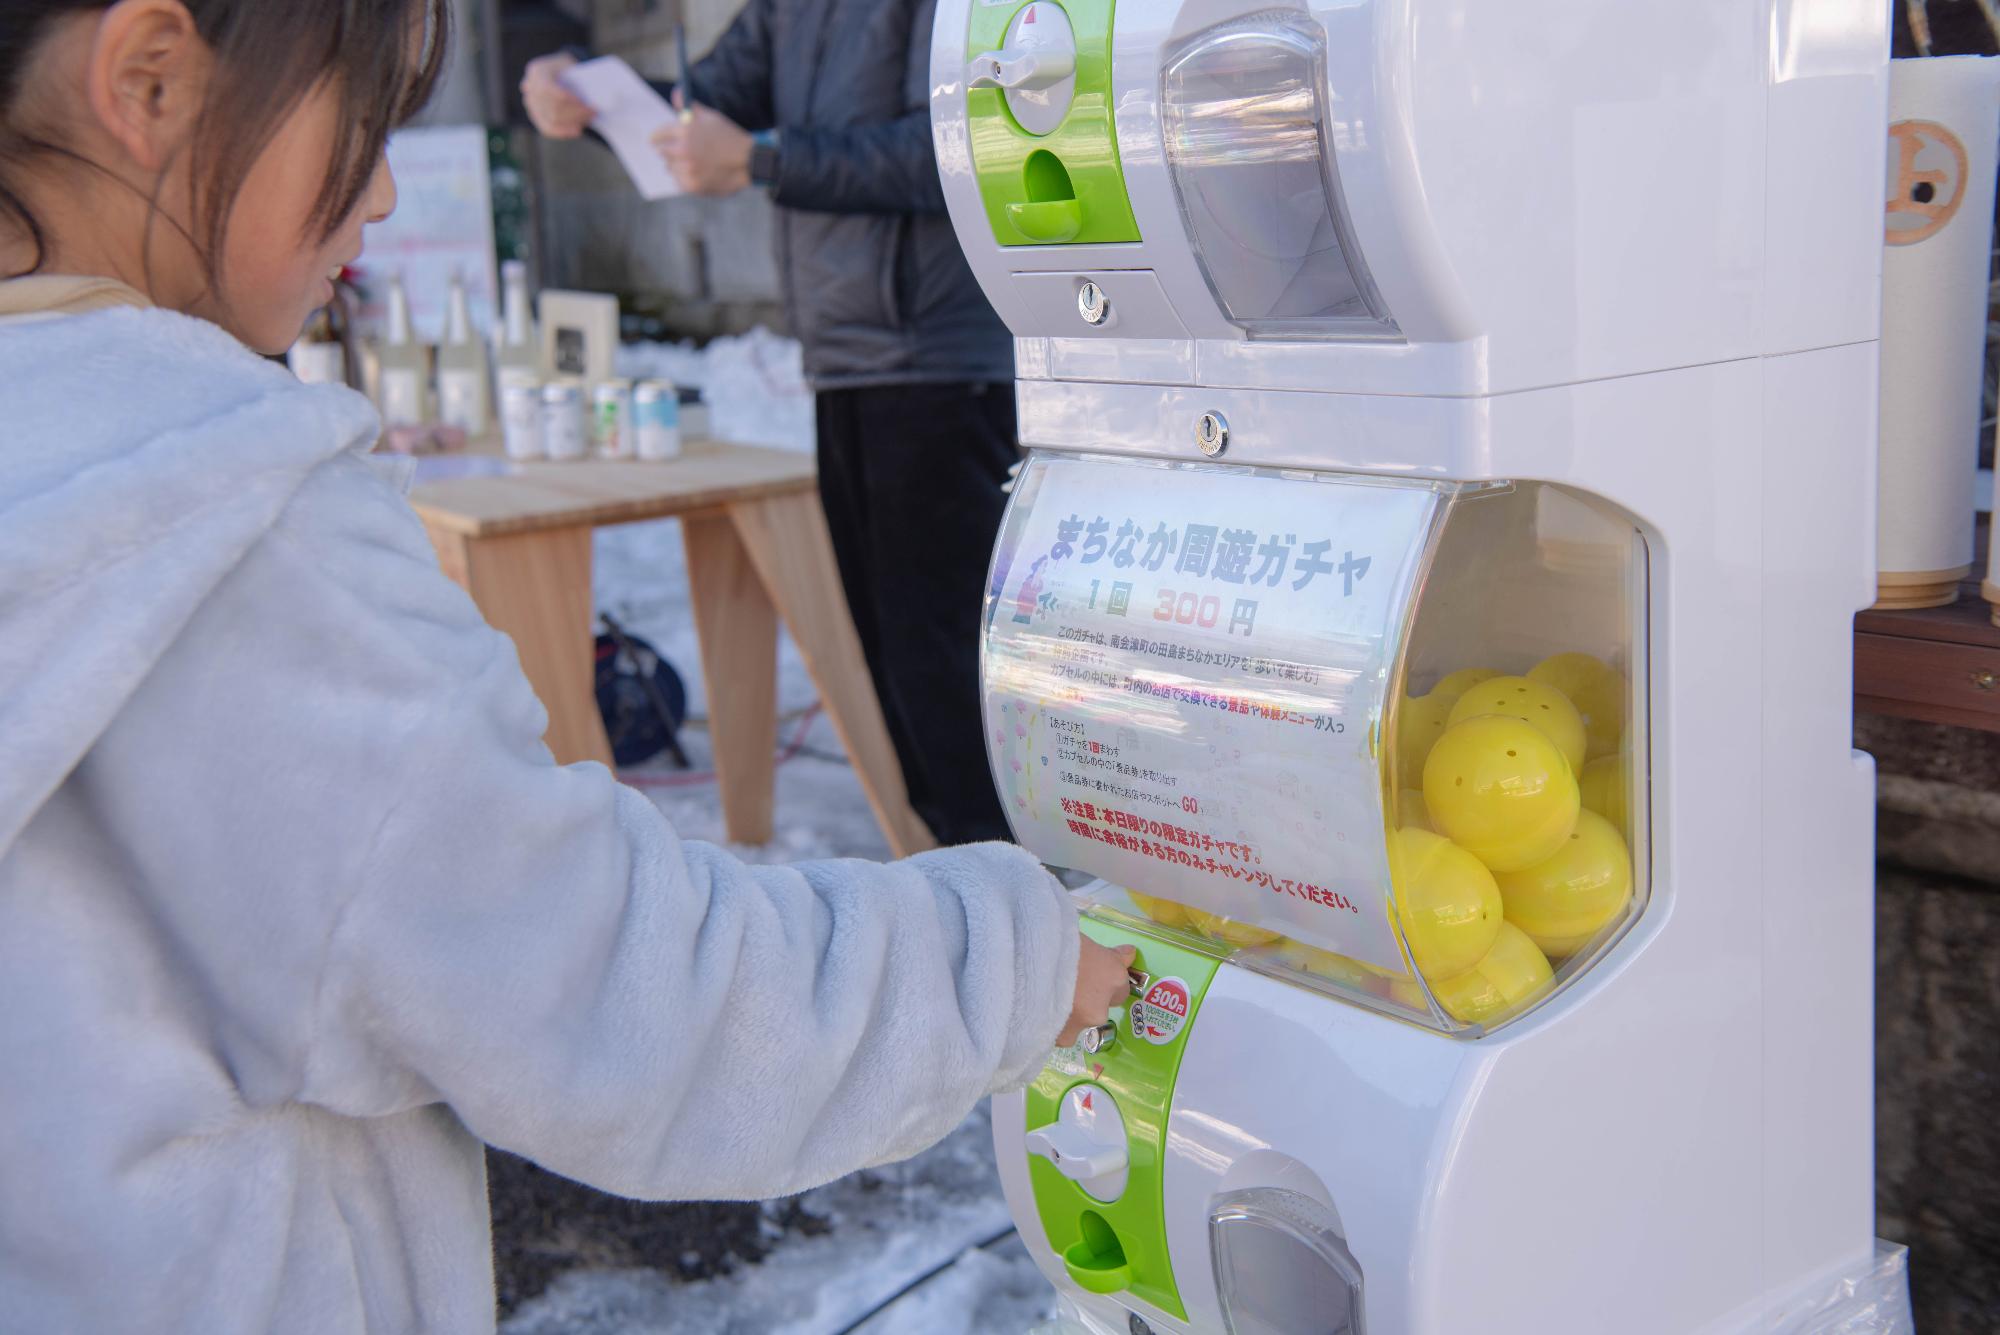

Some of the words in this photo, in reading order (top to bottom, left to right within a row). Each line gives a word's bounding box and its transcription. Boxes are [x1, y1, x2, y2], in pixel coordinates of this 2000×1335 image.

[1050, 513, 1372, 597] まちなか周遊ガチャ
[1066, 818, 1359, 914] 時間に余裕がある方のみチャレンジしてください。
